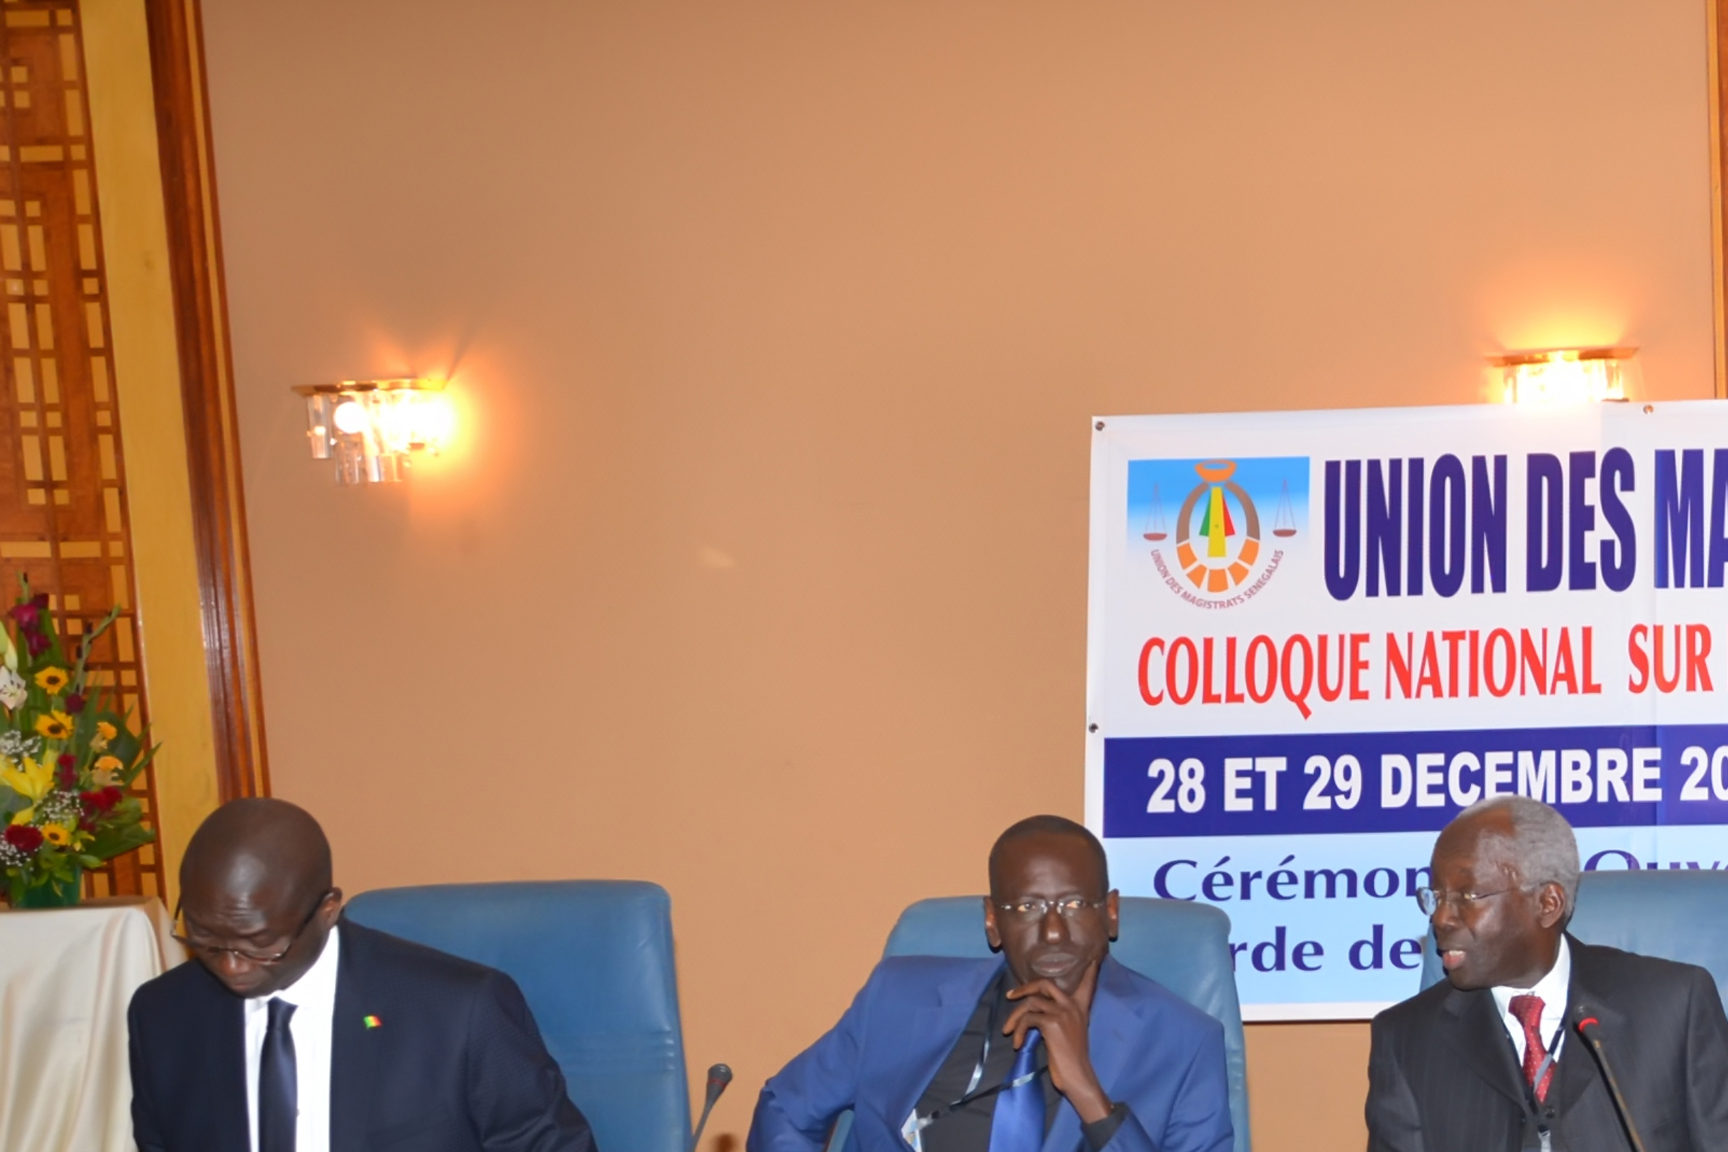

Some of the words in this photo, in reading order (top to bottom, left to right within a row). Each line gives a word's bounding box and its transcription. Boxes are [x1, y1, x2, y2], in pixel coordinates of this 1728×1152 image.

[1324, 454, 1507, 601] UNION
[1526, 447, 1637, 592] DES
[1150, 549, 1168, 579] UNION
[1165, 576, 1182, 595] DES
[1181, 590, 1245, 610] MAGISTRATS
[1243, 549, 1284, 599] SENEGALAIS
[1138, 633, 1370, 720] COLLOQUE
[1385, 626, 1602, 700] NATIONAL
[1628, 623, 1714, 694] SUR
[1146, 757, 1205, 813] 28
[1223, 756, 1287, 811] ET
[1302, 754, 1362, 810] 29
[1380, 747, 1662, 808] DECEMBRE
[1152, 854, 1432, 901] Cérémon
[1228, 925, 1324, 972] rde
[1348, 923, 1422, 971] de
